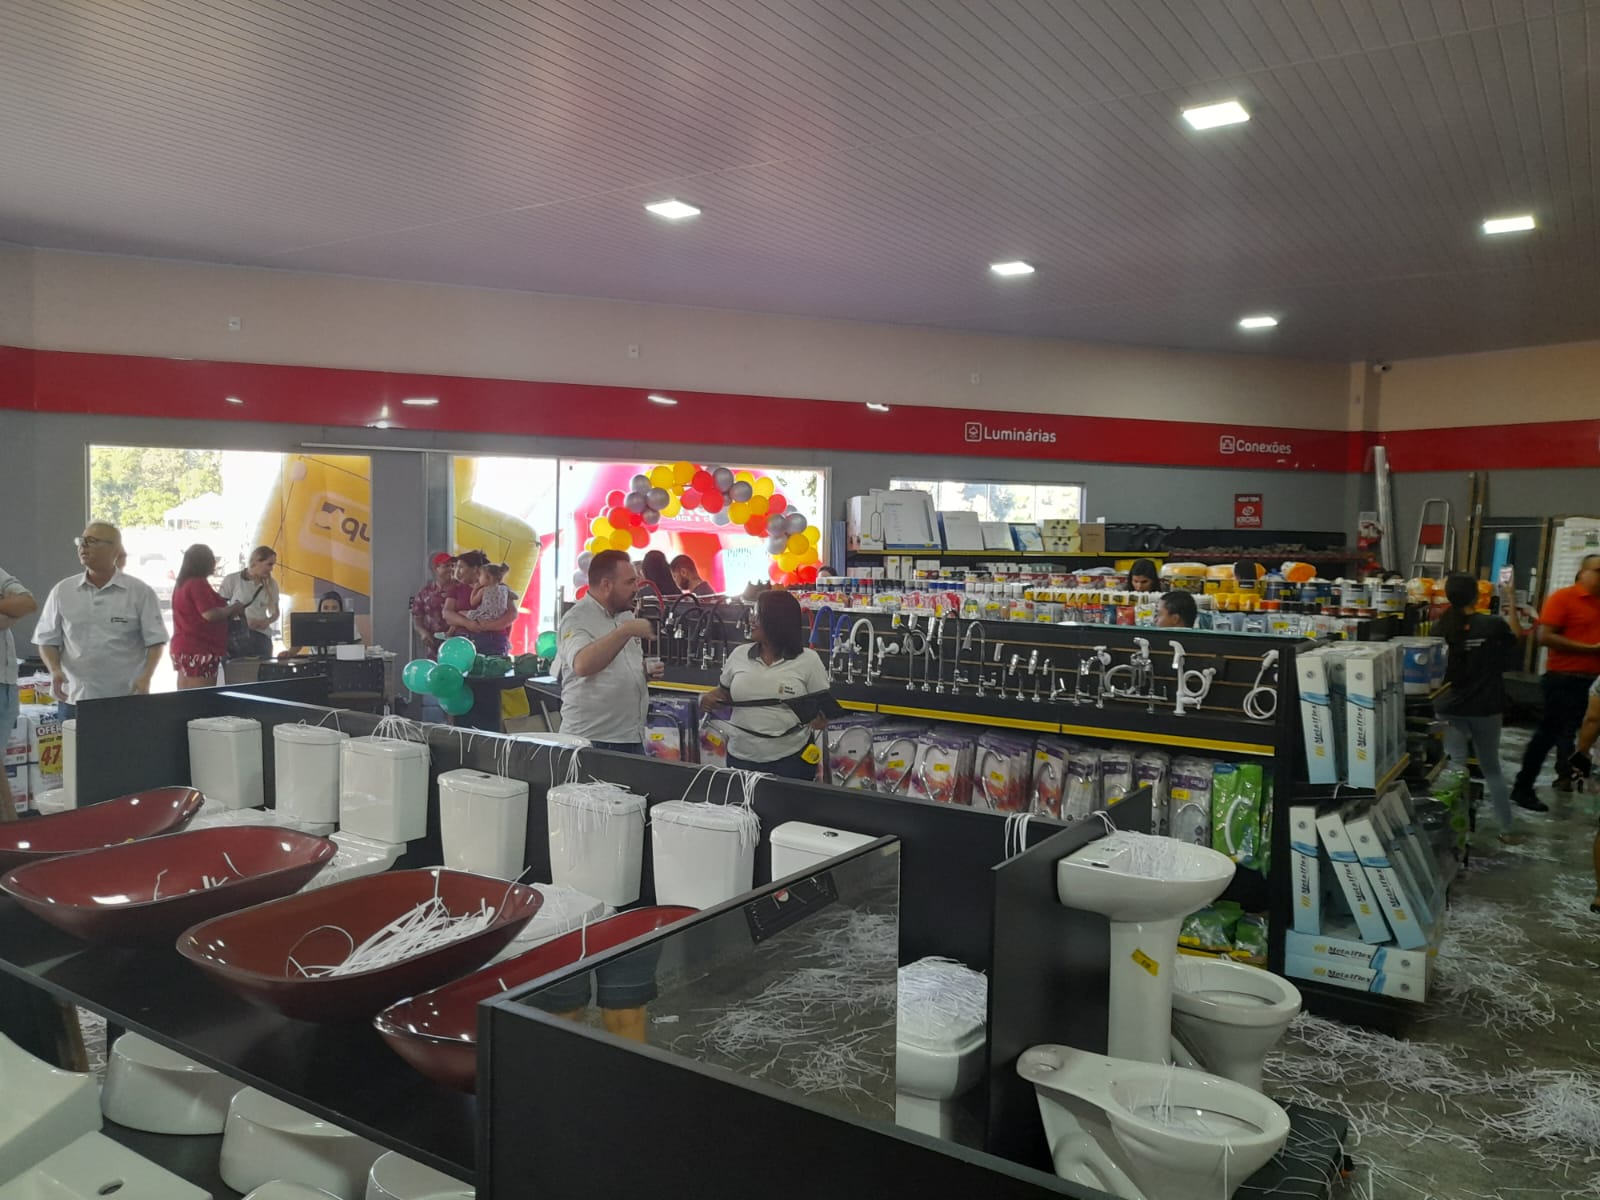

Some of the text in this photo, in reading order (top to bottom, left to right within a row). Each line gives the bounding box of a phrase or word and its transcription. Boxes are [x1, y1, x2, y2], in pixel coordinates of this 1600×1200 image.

[983, 426, 1057, 443] Luminárias
[1236, 439, 1292, 455] Conexões
[41, 745, 62, 765] 47
[1327, 946, 1372, 960] Metalflex
[1327, 969, 1371, 984] Metalflex
